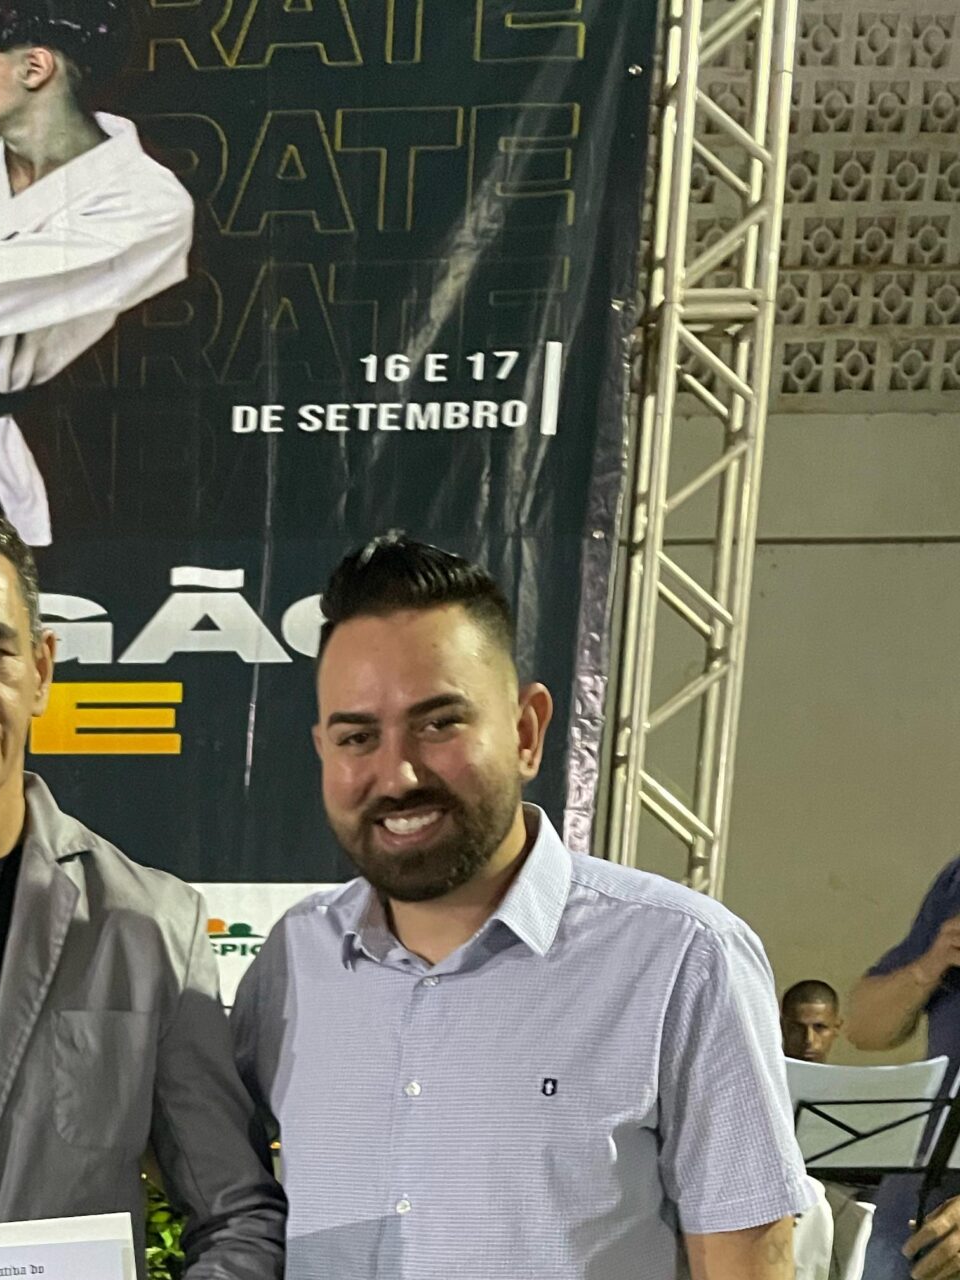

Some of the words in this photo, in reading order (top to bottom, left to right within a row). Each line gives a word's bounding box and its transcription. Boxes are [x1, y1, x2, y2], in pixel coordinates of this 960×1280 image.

[359, 354, 410, 383] 16
[424, 353, 449, 382] E
[466, 350, 519, 381] 17
[231, 405, 285, 433] DE
[297, 399, 528, 432] SETEMBRO
[30, 1265, 45, 1274] do
